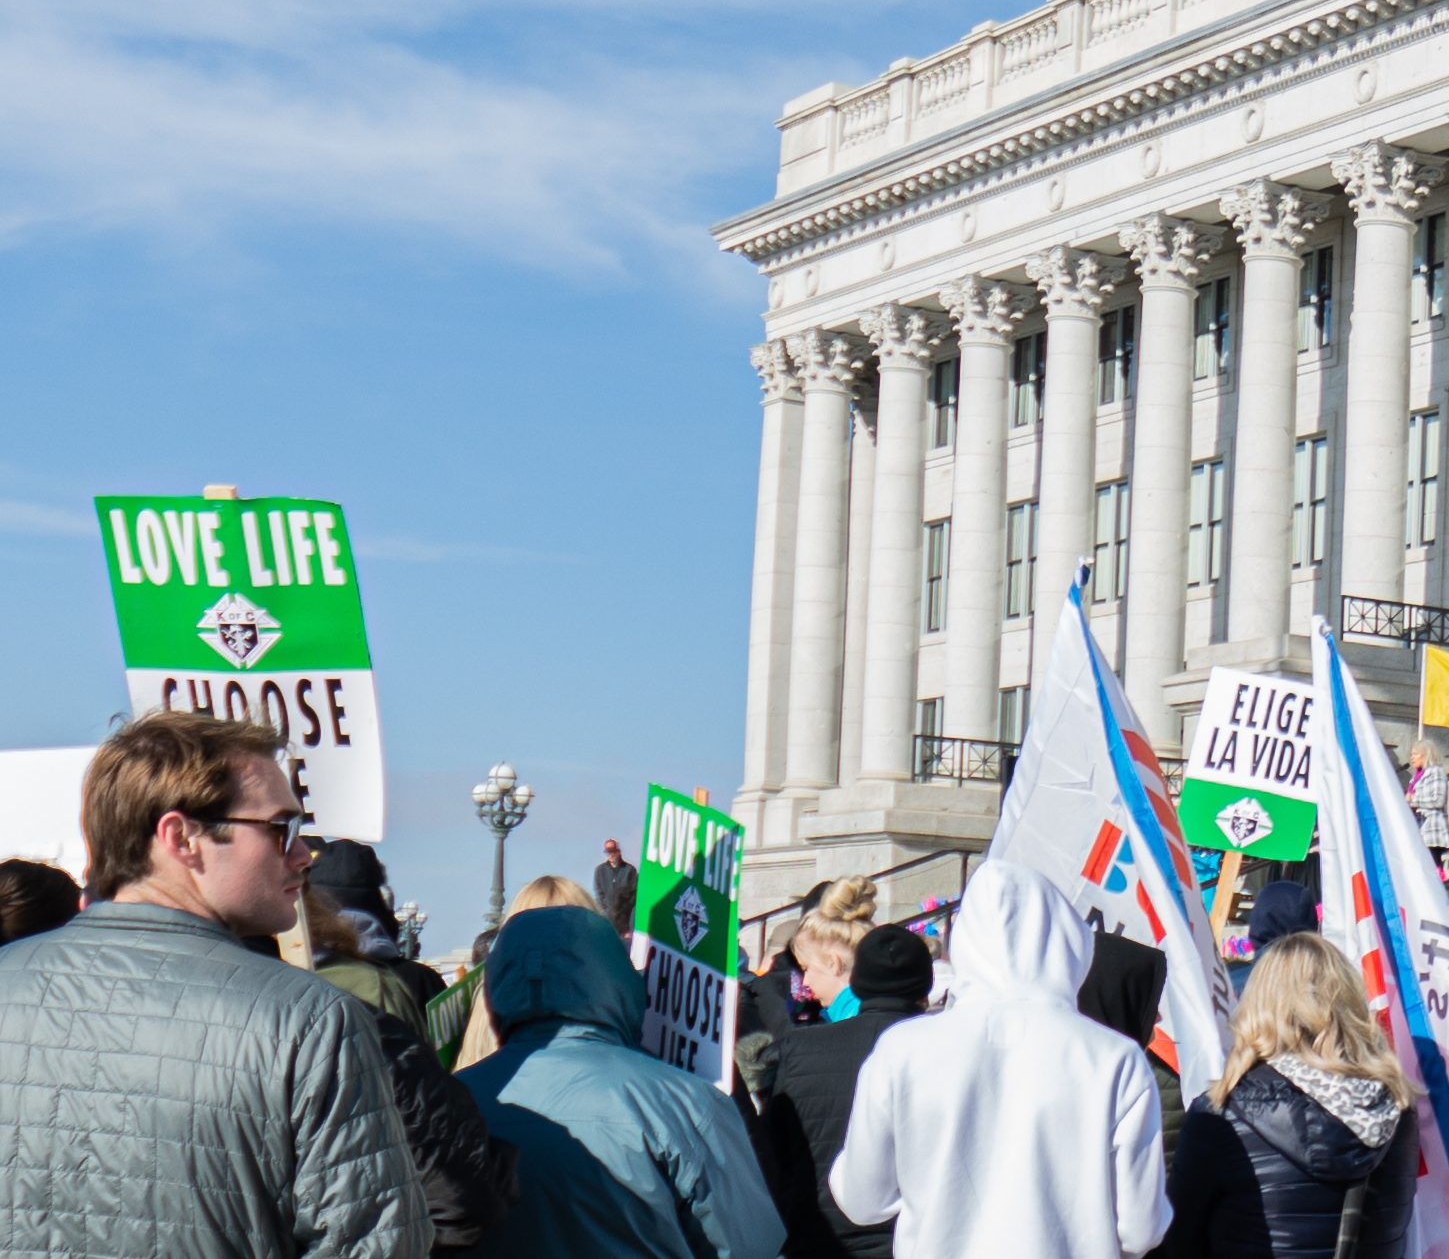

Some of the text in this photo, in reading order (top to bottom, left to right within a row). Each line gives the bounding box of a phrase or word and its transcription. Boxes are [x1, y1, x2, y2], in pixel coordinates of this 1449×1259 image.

[108, 509, 347, 587] LOVE LIFE
[217, 611, 226, 622] K
[245, 611, 255, 622] C
[1229, 683, 1314, 739] ELIGE
[1204, 727, 1312, 789] LA VIDA
[646, 795, 741, 902] LOVE LIFE
[644, 945, 724, 1044] CHOOSE
